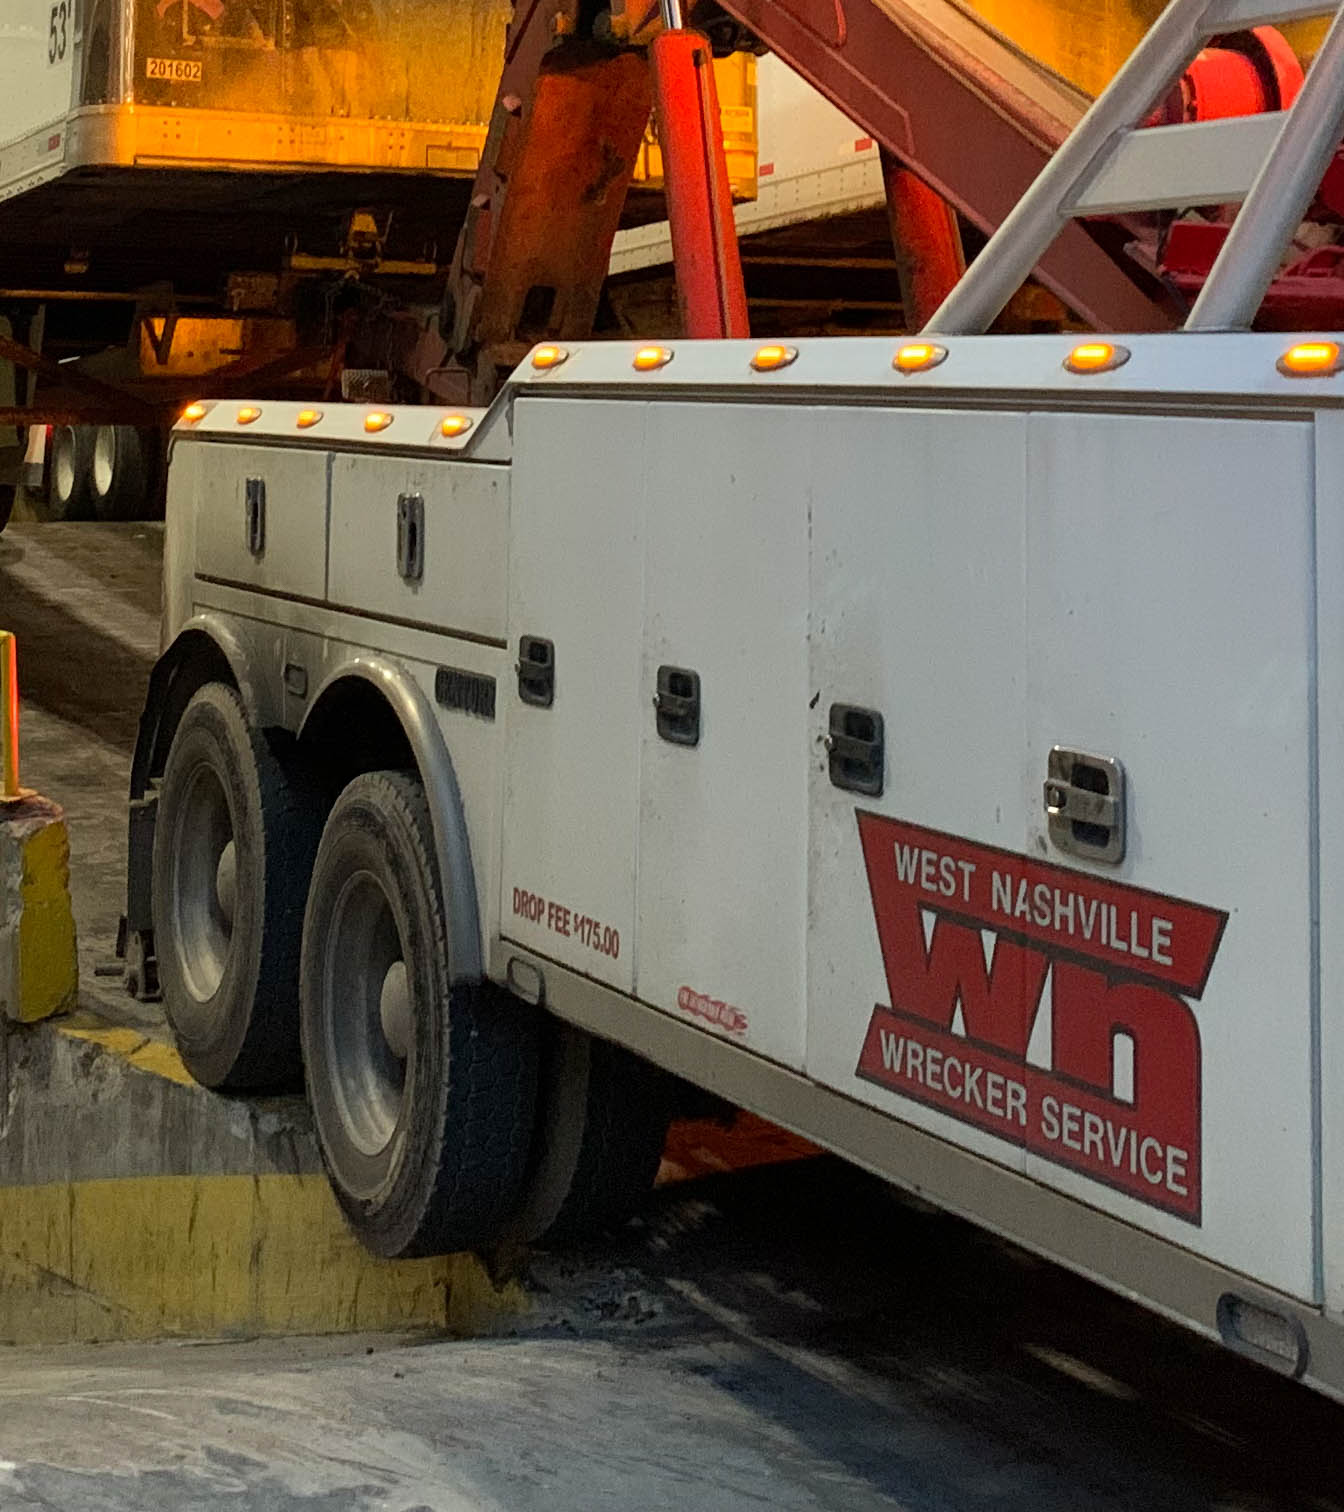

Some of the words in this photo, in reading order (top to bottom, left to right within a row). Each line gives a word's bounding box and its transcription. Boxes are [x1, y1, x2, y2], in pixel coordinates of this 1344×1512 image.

[150, 61, 201, 79] 201602
[513, 887, 545, 923] DROP
[548, 901, 571, 937] FEE
[574, 912, 620, 960] $175.00
[895, 841, 976, 901] WEST
[992, 870, 1173, 966] NASHVILLE
[880, 1029, 1027, 1126] WRECKER
[1041, 1095, 1188, 1195] SERVICE
